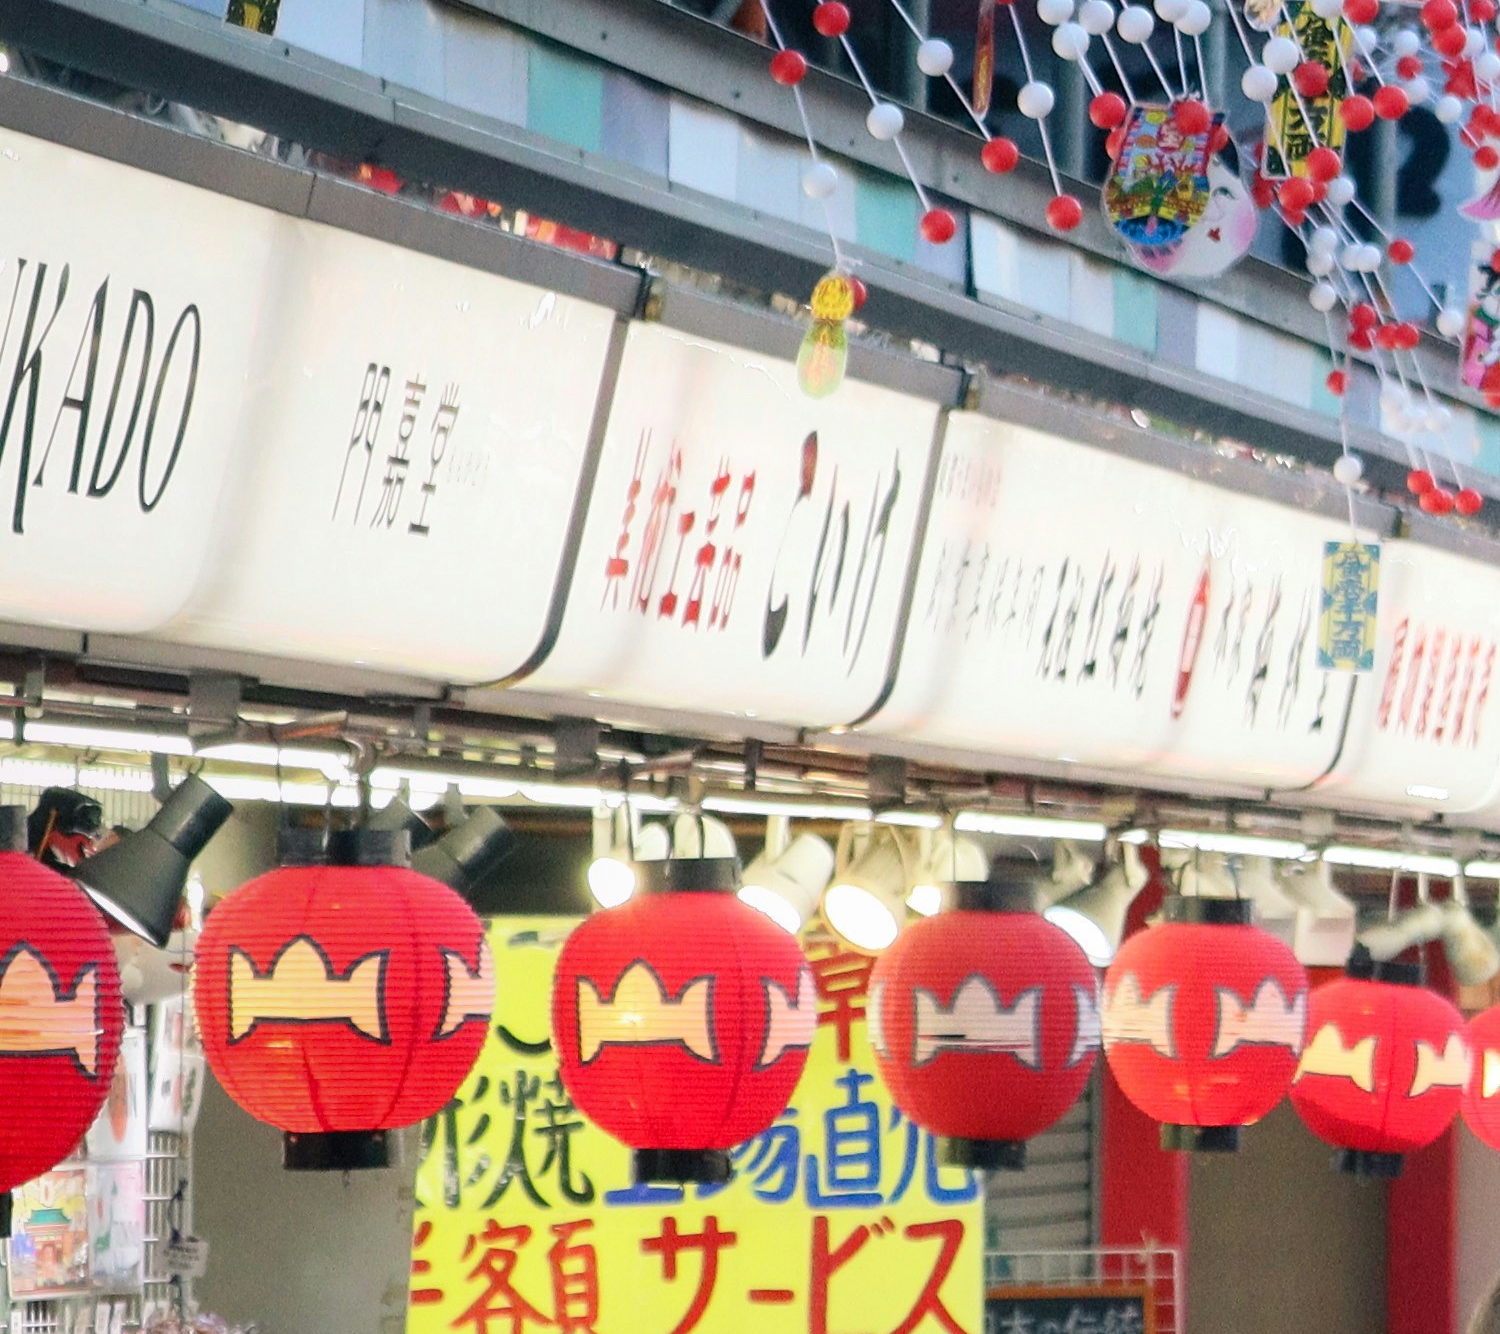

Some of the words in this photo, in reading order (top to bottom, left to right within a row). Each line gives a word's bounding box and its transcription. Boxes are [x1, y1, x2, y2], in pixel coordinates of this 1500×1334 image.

[600, 427, 756, 633] 美術工芸品
